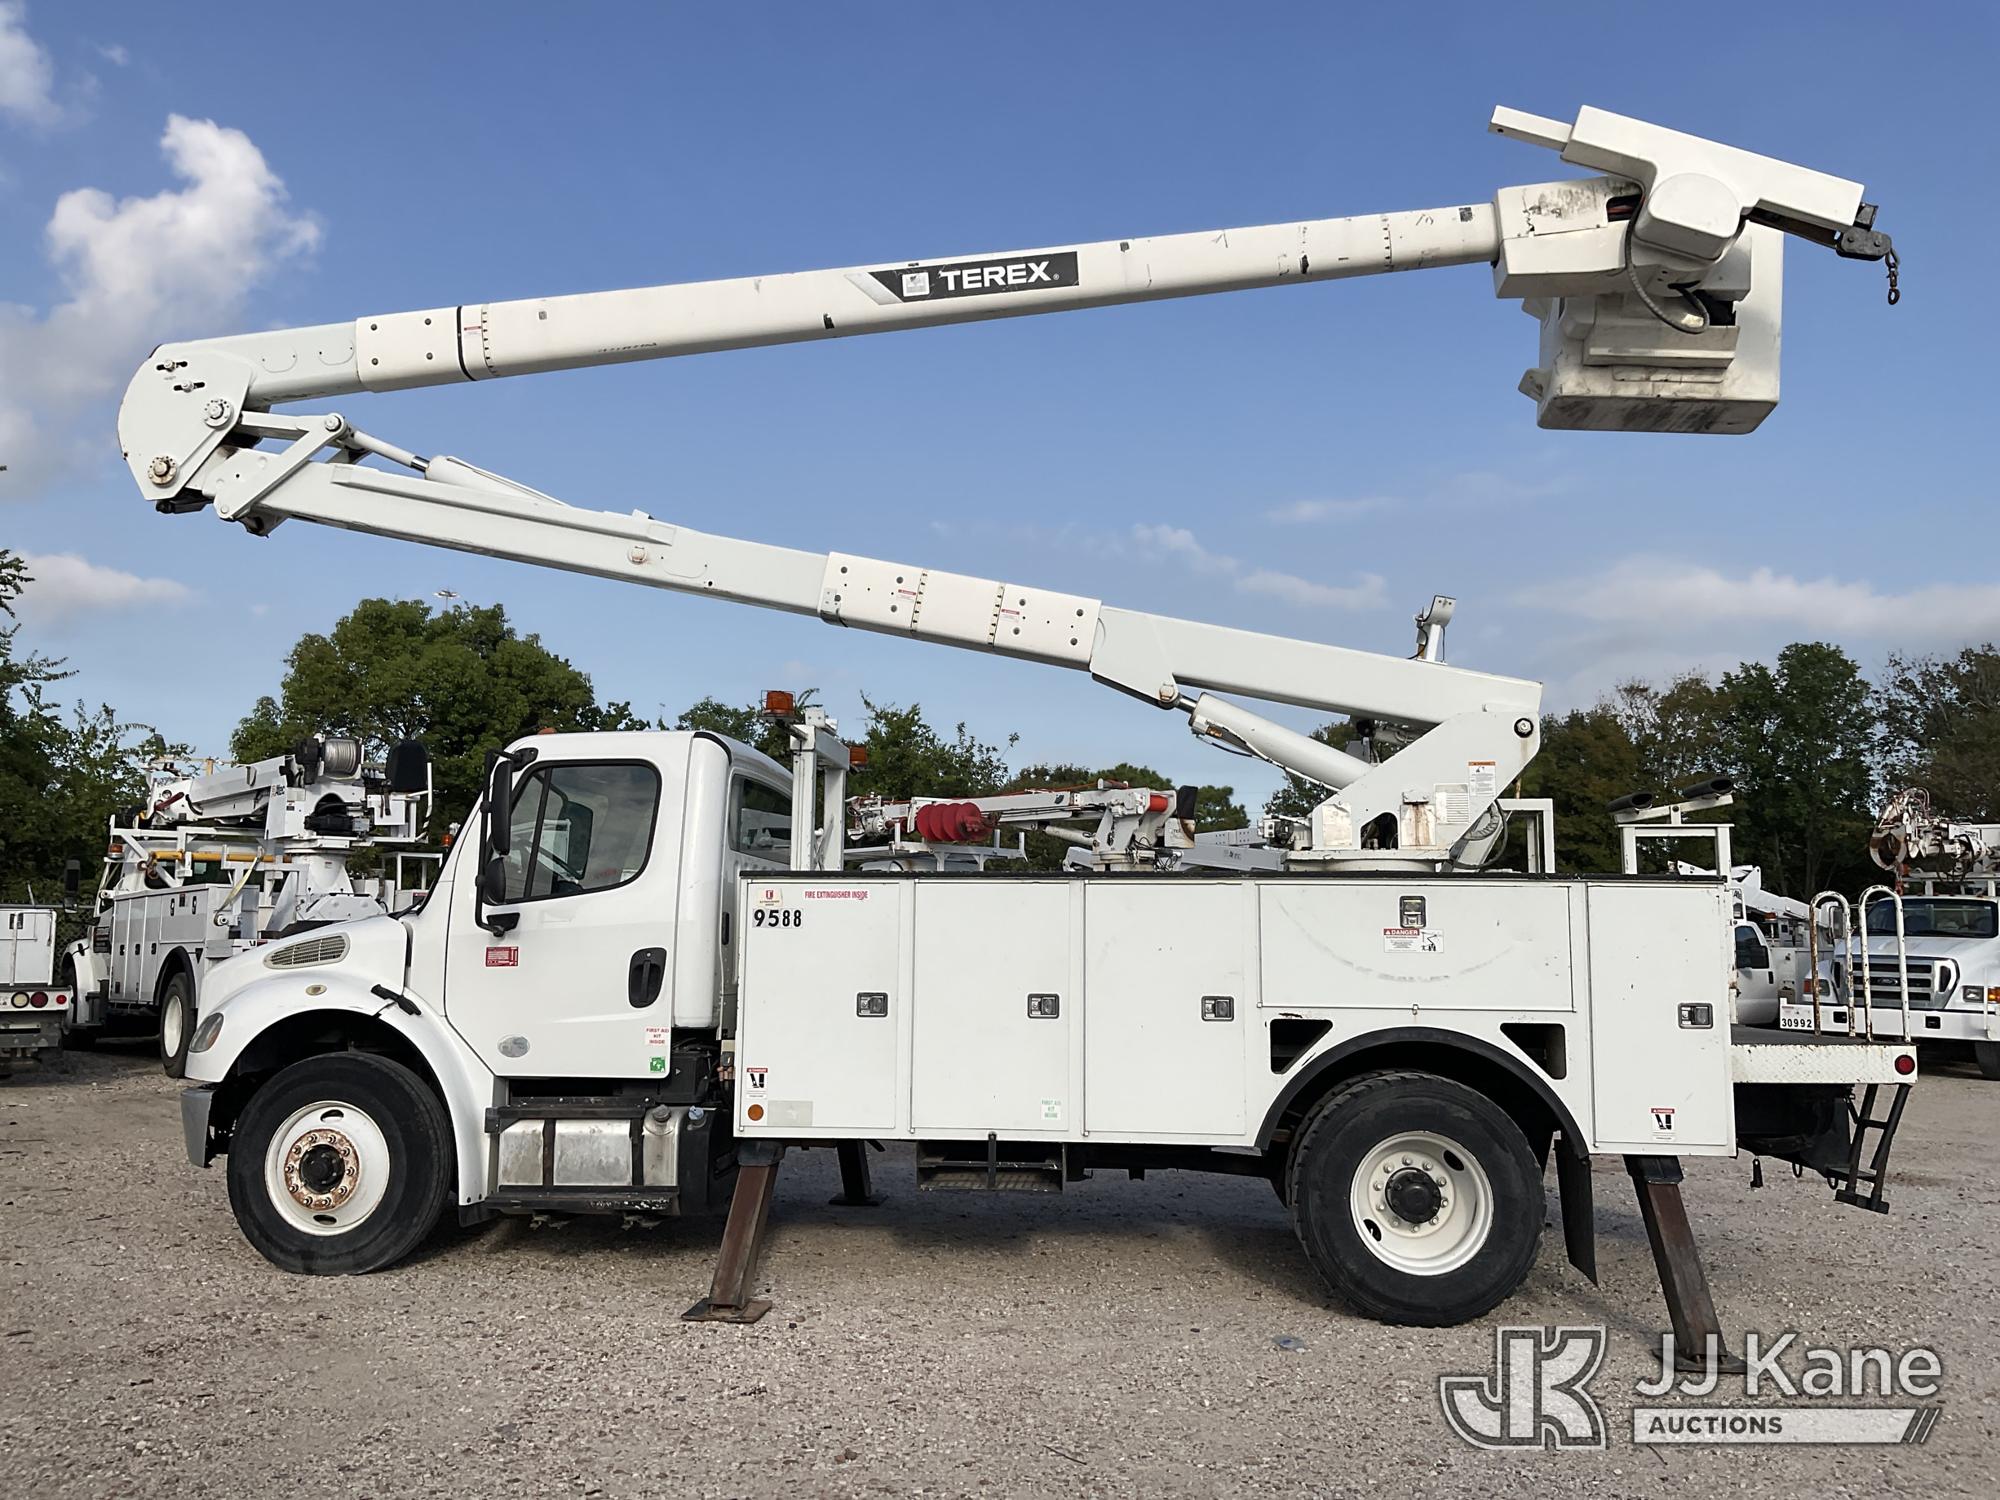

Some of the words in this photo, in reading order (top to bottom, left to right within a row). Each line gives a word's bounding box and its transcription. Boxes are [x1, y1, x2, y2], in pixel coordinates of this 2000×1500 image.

[940, 261, 1052, 291] TEREX
[804, 890, 815, 899] FIRE
[816, 890, 851, 899] EXTINGUISHER
[753, 909, 802, 928] 9588
[1781, 1018, 1812, 1028] 30992
